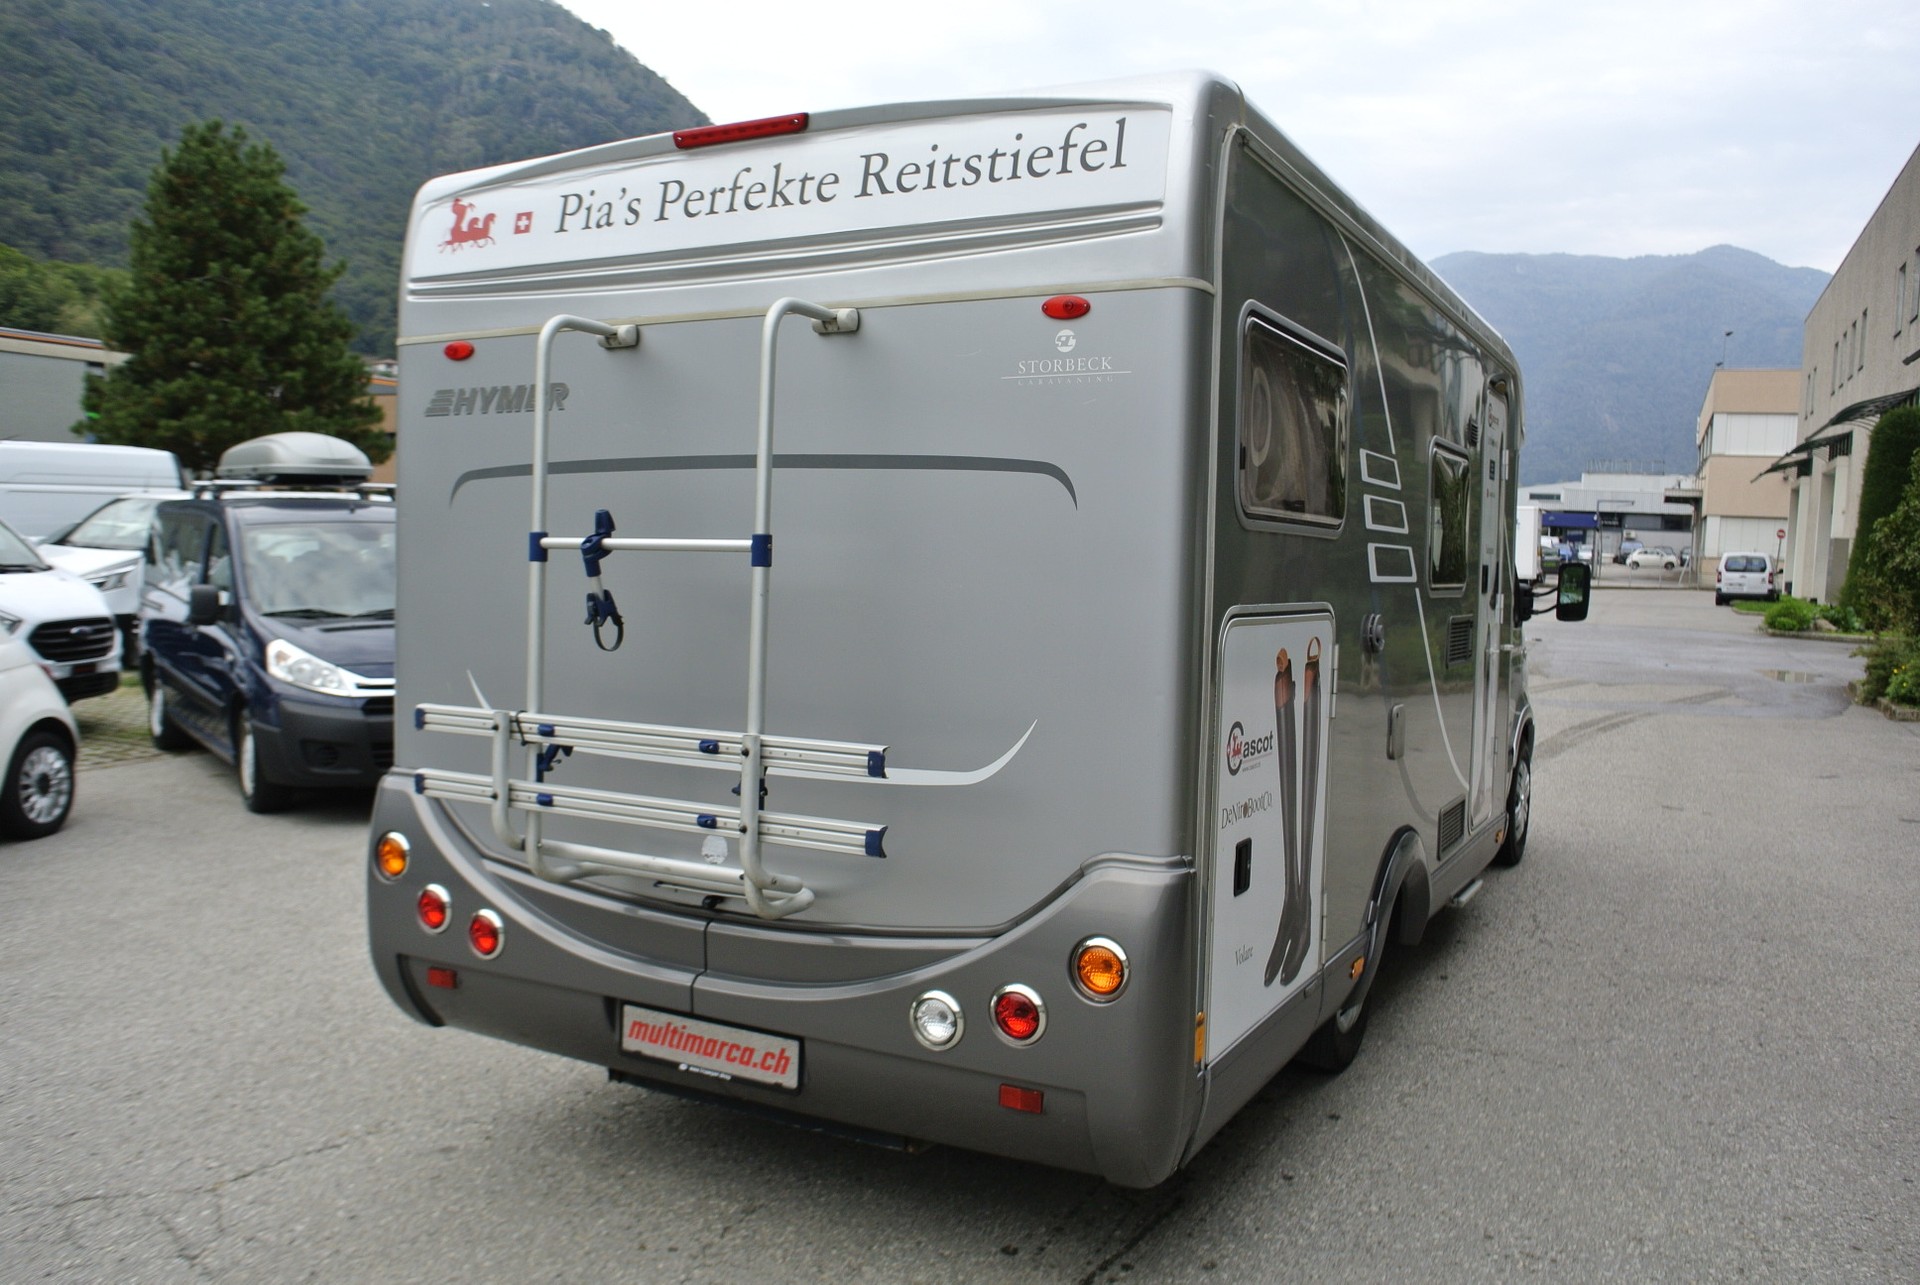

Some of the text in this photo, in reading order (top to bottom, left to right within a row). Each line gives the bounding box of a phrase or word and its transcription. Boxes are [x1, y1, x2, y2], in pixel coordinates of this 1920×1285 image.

[554, 116, 1128, 234] Pia's Perfekte Reitstiefel
[1018, 356, 1113, 375] STORBECK
[1018, 375, 1114, 386] CARAVANING
[627, 1018, 793, 1076] multimarca.ch
